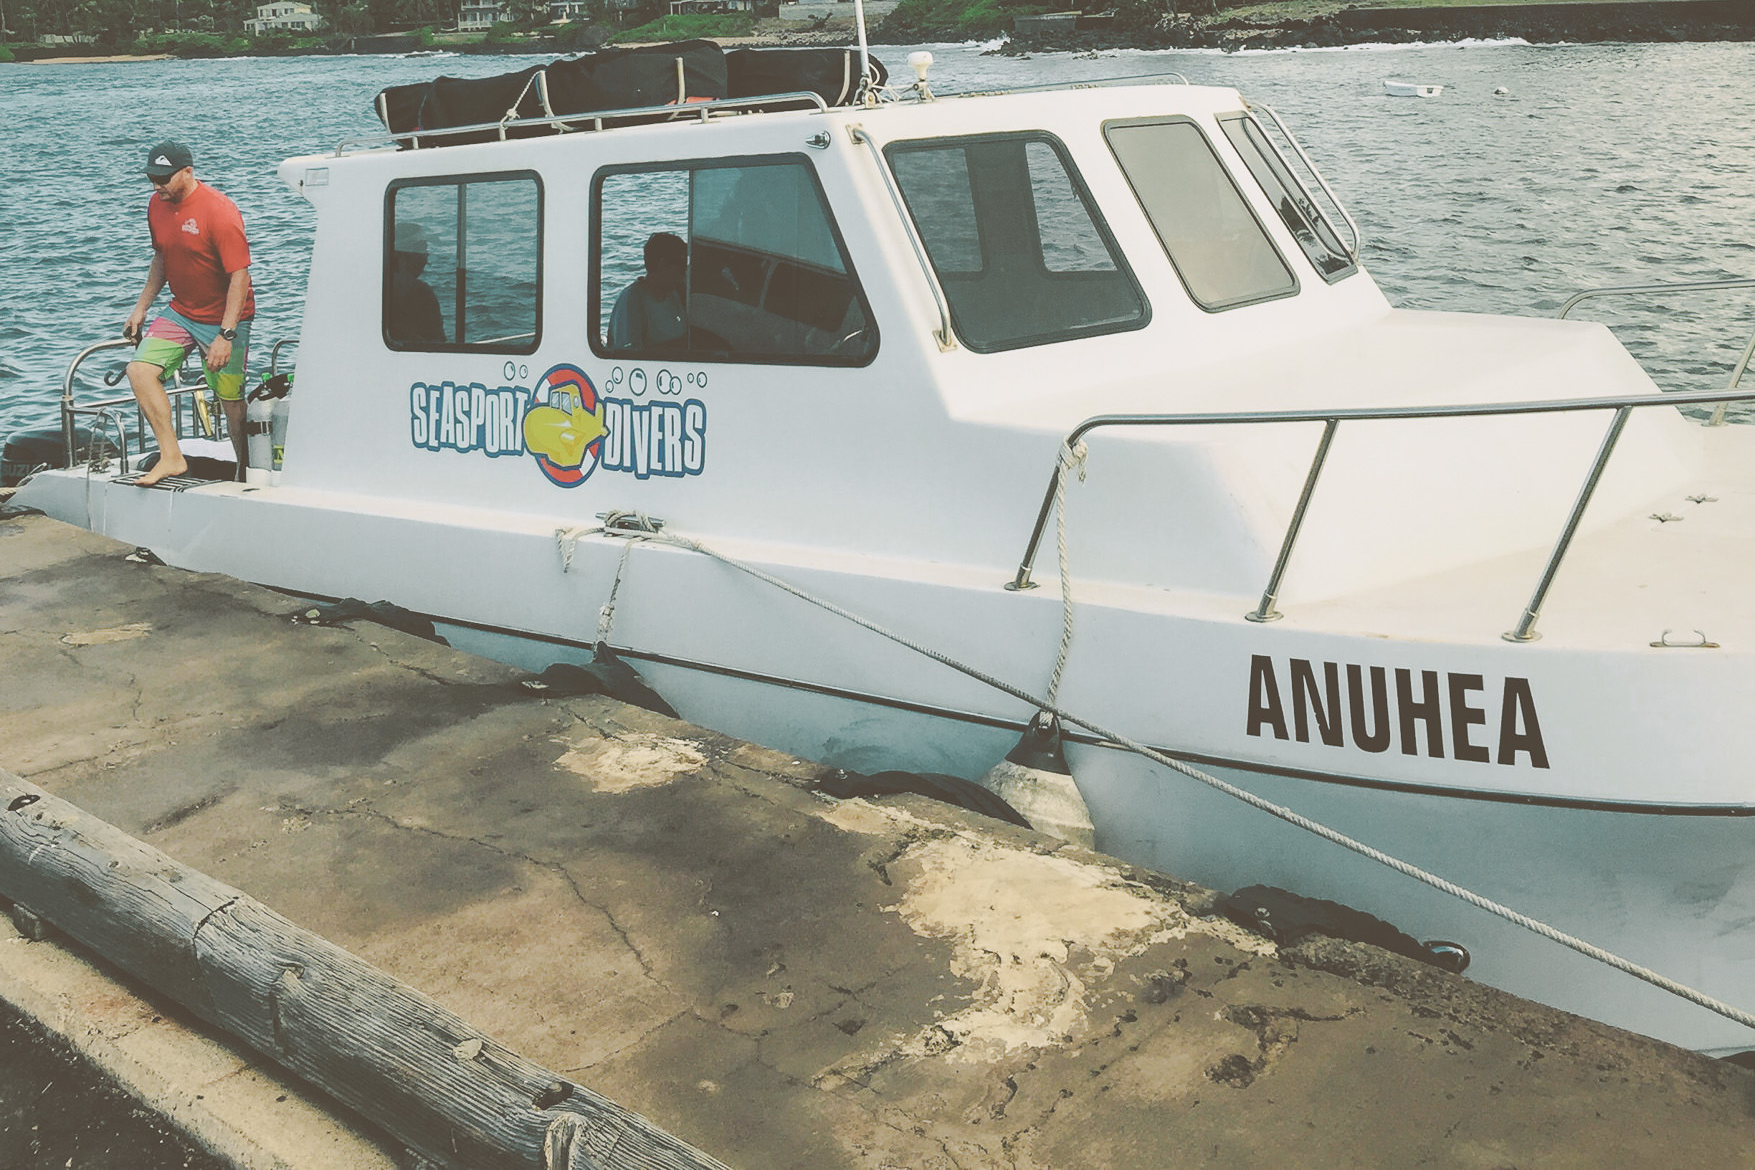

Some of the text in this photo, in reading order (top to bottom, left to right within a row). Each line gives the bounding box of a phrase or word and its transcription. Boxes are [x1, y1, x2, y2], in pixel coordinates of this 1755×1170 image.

[2, 463, 52, 477] SUZ
[411, 382, 707, 479] SEASPORT DIVERS
[1246, 654, 1550, 769] ANUHEA
